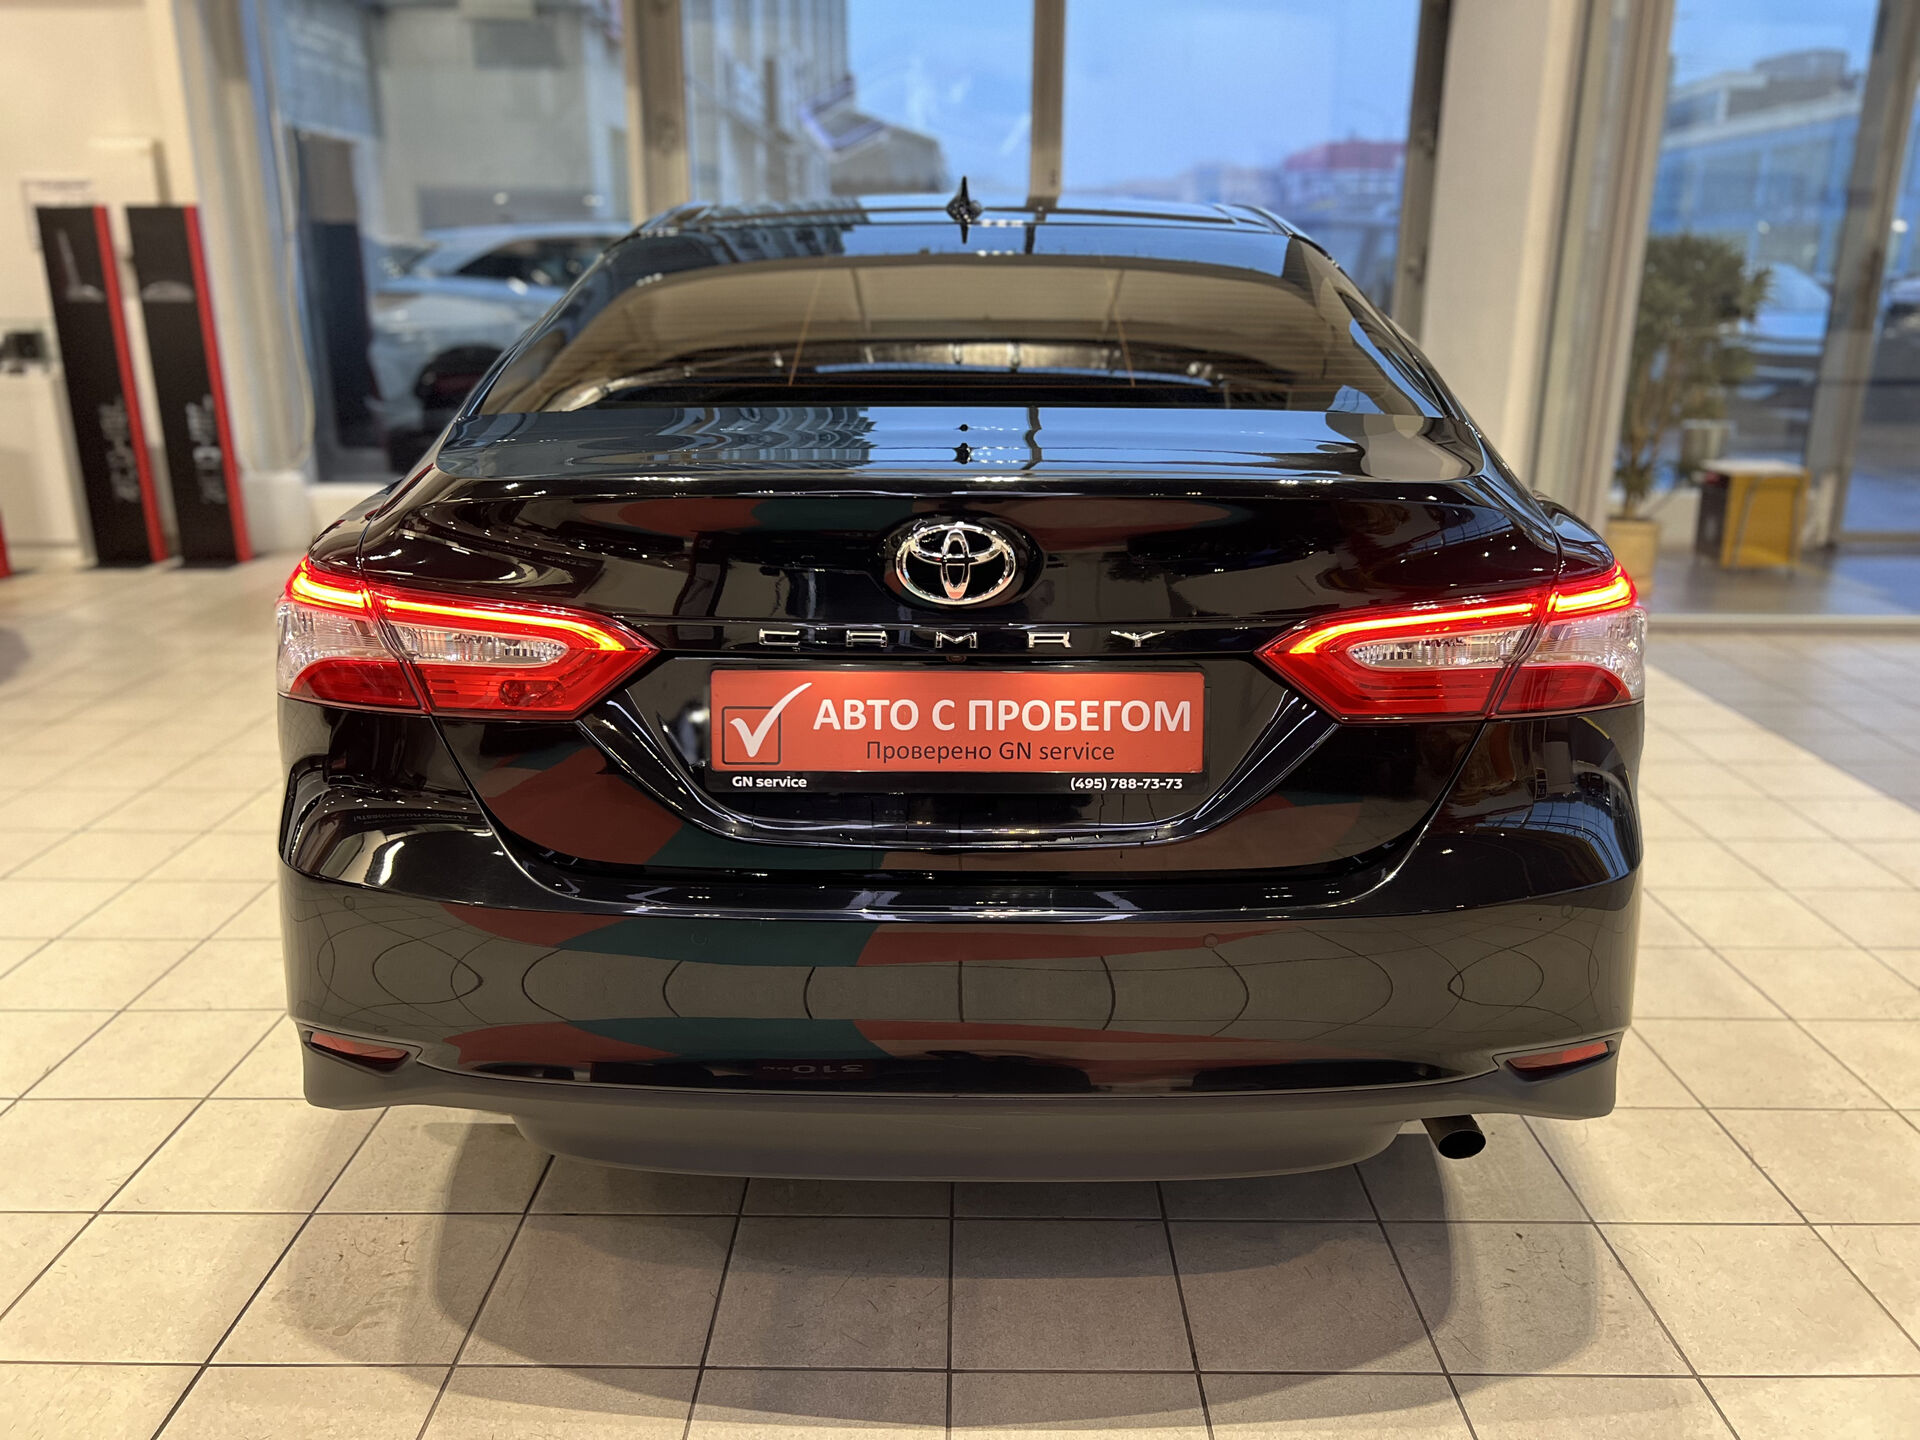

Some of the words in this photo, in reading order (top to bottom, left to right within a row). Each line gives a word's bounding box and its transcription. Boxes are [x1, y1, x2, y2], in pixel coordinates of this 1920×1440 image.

[758, 629, 1166, 648] CAMRY
[813, 699, 919, 731] АВТО
[931, 699, 956, 731] С
[968, 699, 1191, 732] ПРОБЕГОМ
[866, 741, 992, 764] Проверено
[999, 741, 1032, 760] GN
[1039, 741, 1115, 760] service
[732, 776, 753, 788] GN
[755, 776, 808, 788] service
[1070, 777, 1107, 791] (495)
[1110, 778, 1183, 790] 788-73-73
